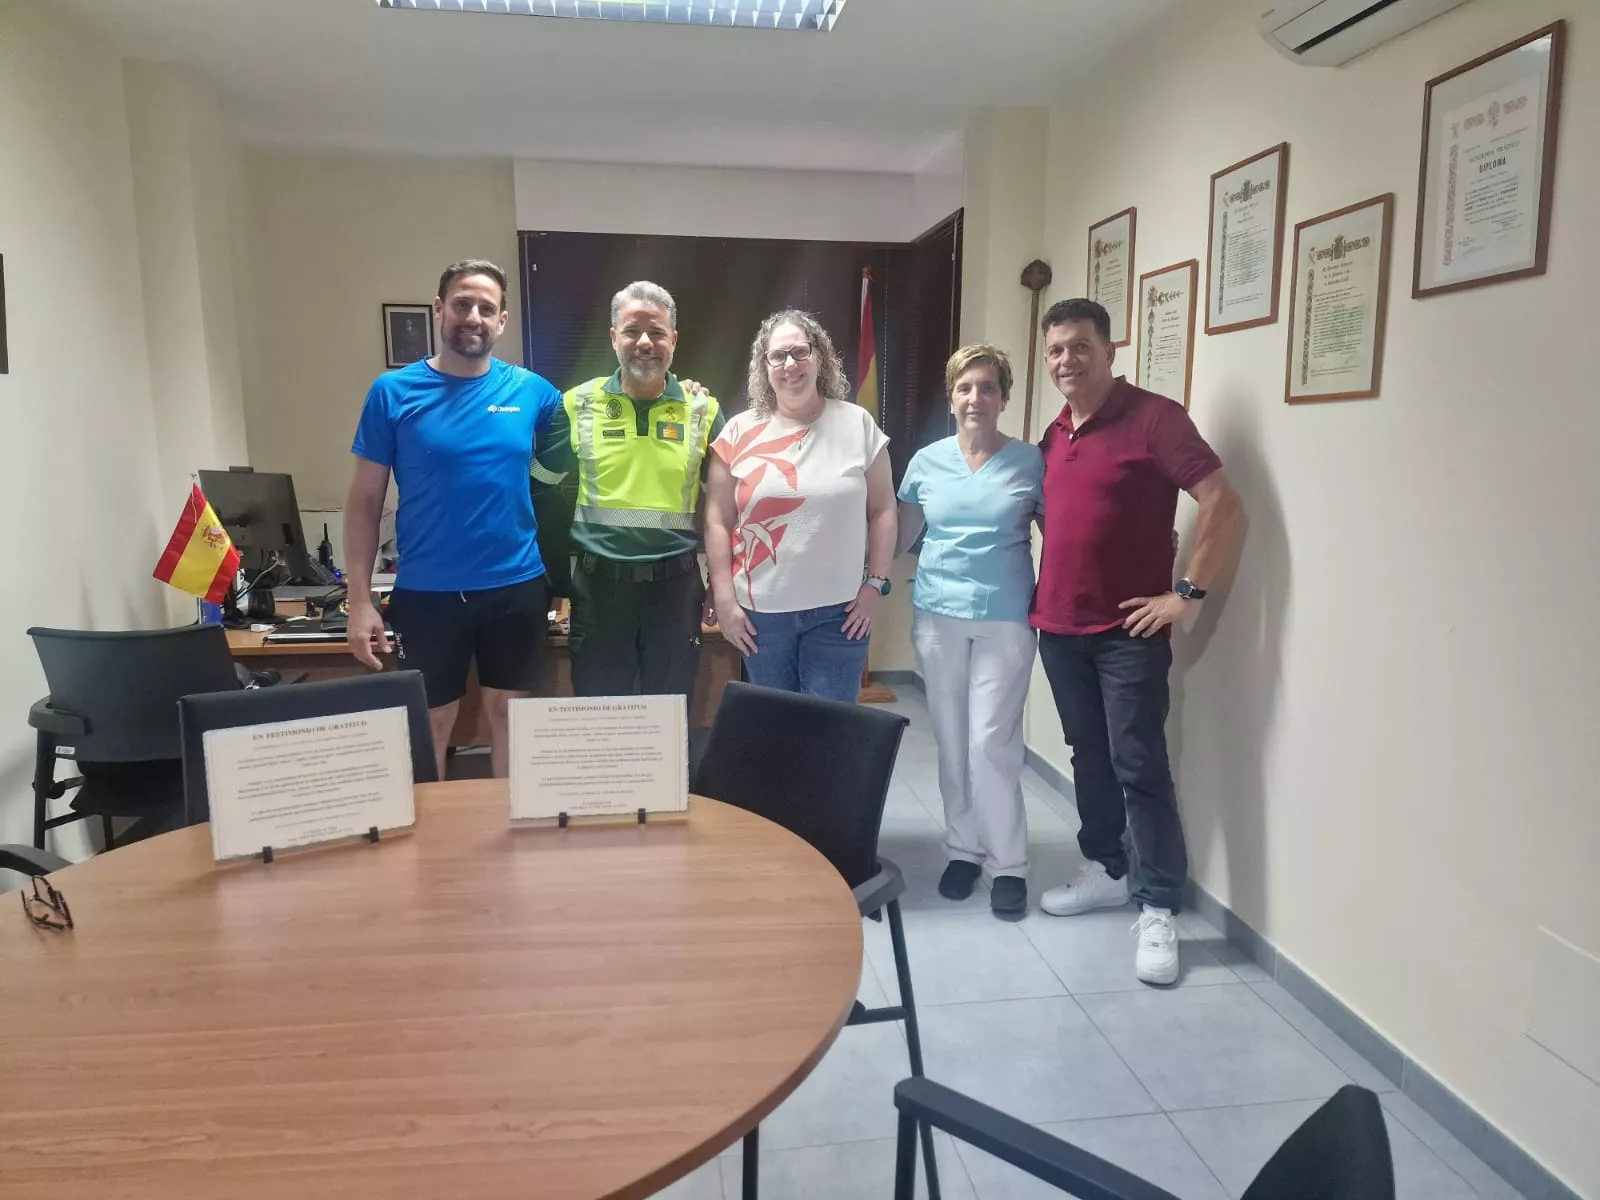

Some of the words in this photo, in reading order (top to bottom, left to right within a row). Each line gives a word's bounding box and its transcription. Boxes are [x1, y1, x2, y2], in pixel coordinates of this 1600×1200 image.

[1479, 155, 1506, 173] DIPLOMA
[560, 704, 601, 713] TESTIMONIO
[602, 704, 611, 712] DE
[612, 703, 648, 712] GRATITUD
[252, 733, 264, 741] EN
[266, 727, 315, 739] TESTIMONIO
[316, 725, 327, 734] DE
[328, 720, 368, 731] GRATITUD
